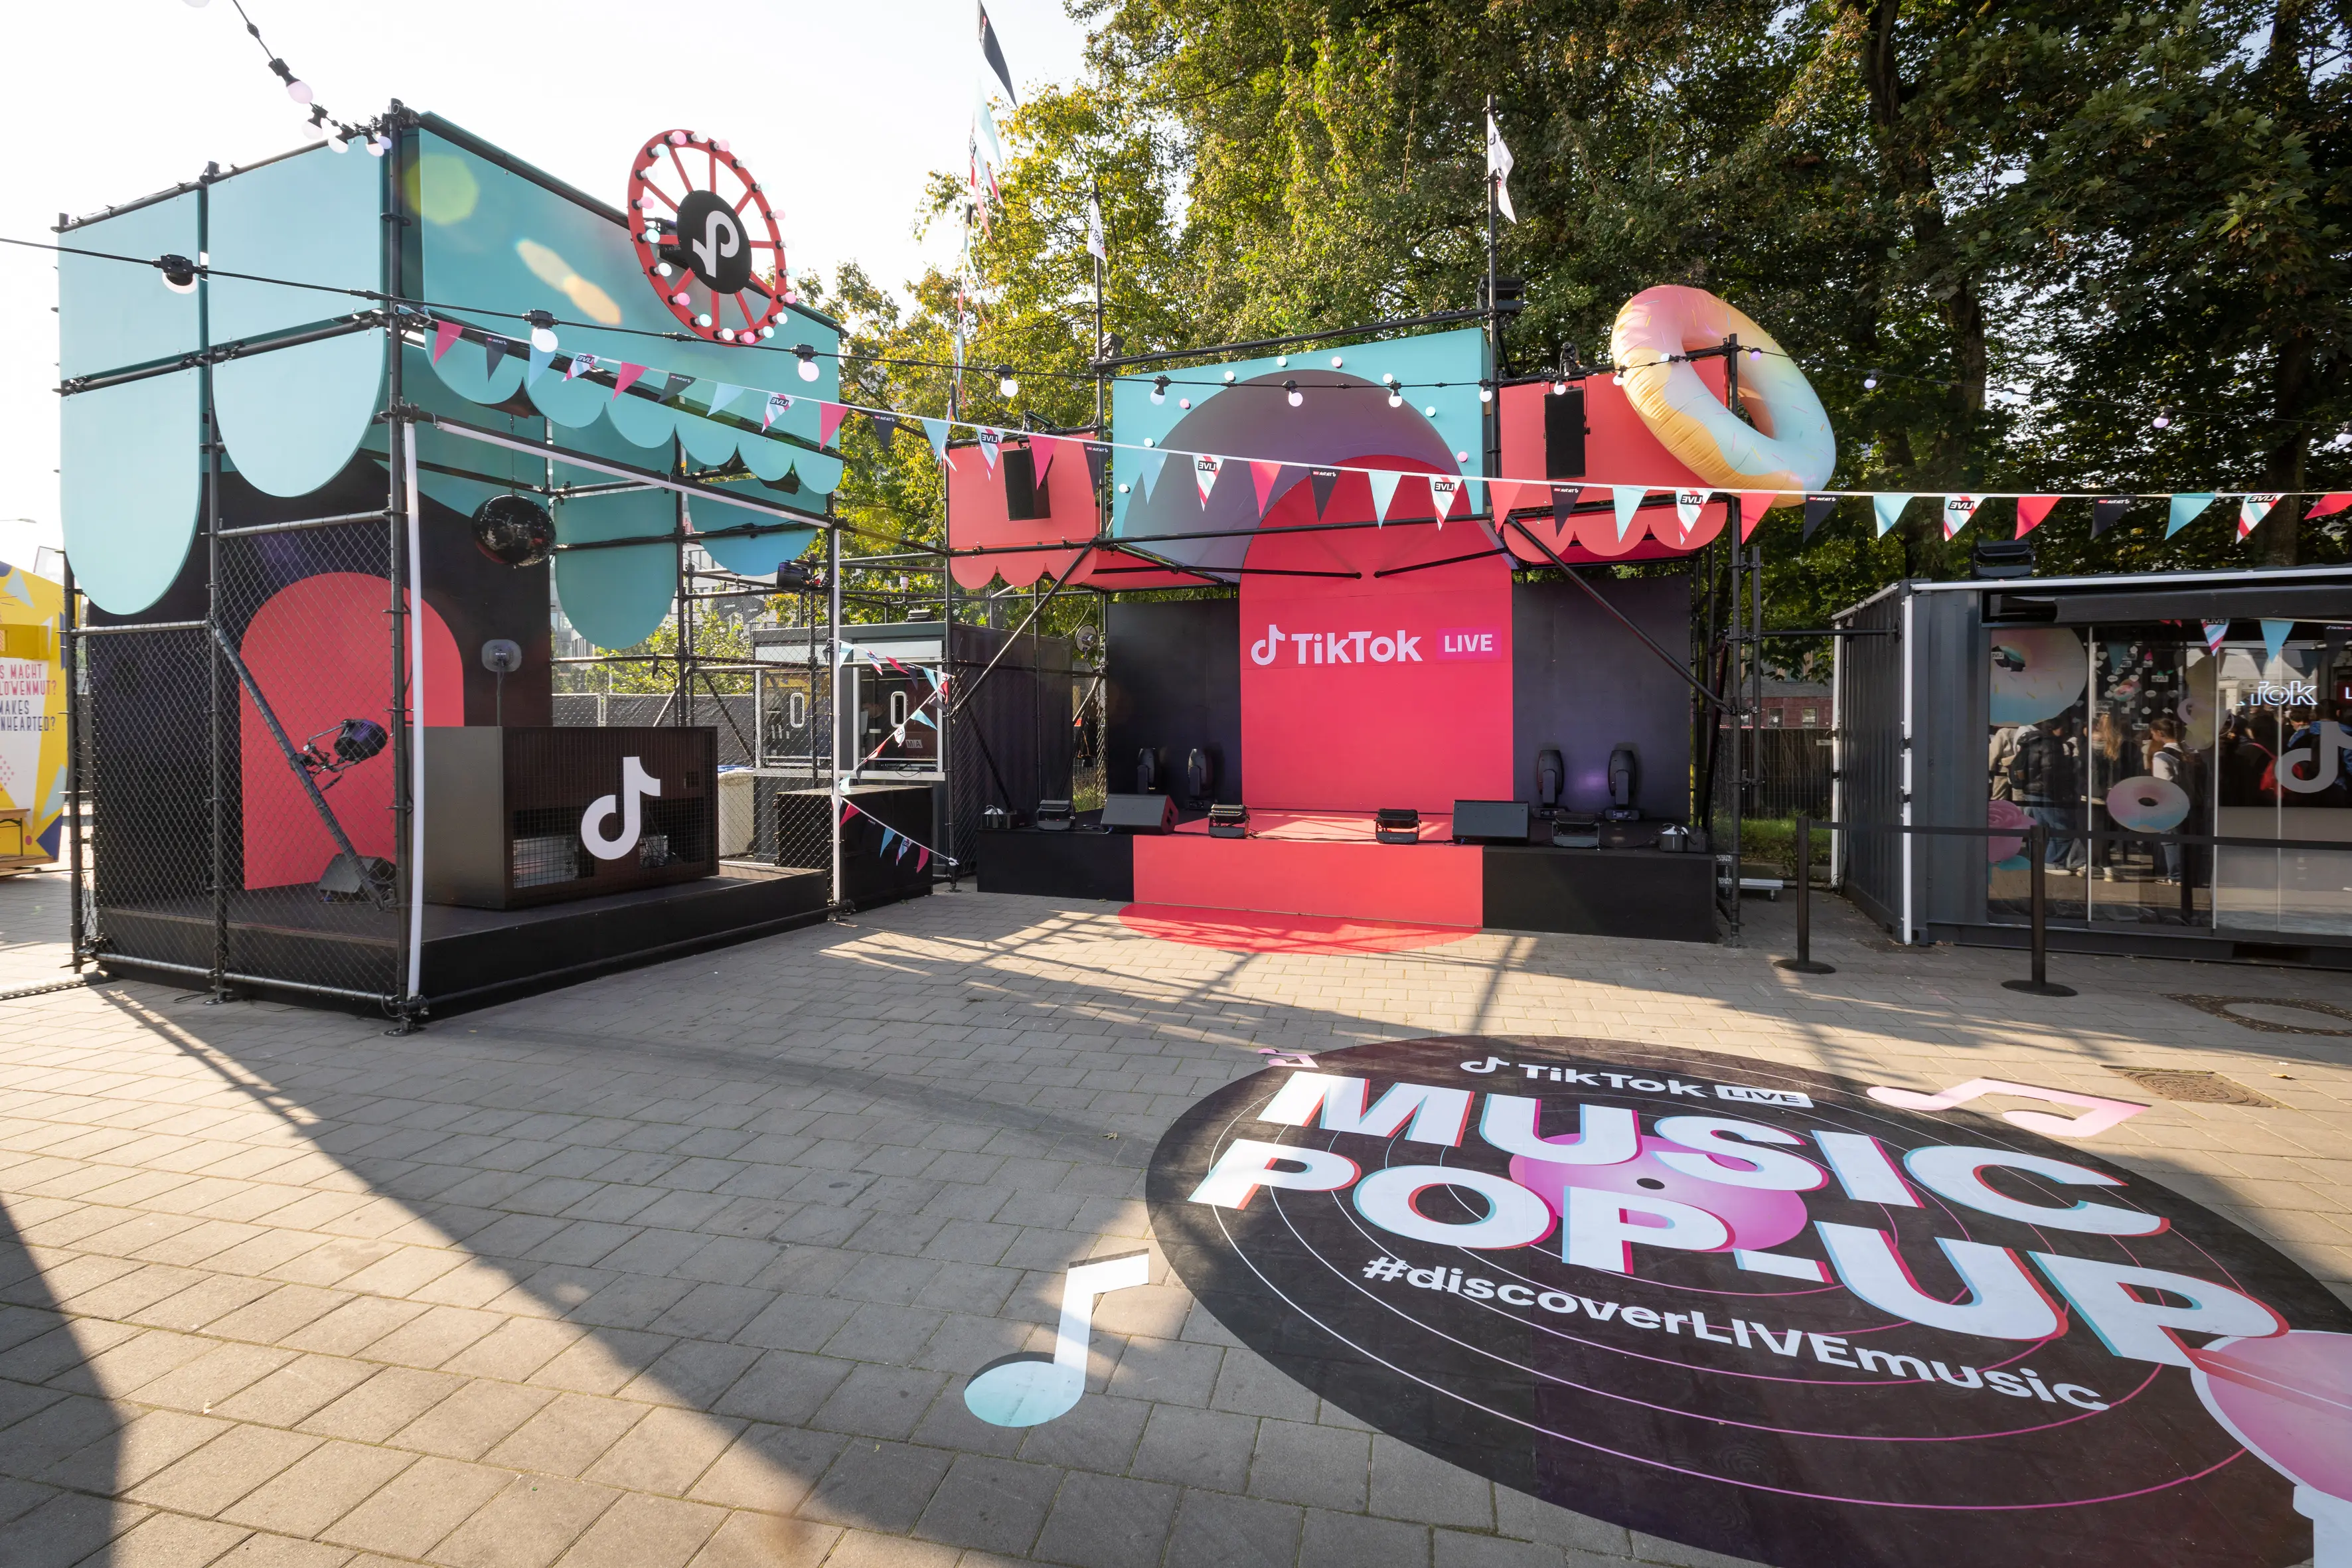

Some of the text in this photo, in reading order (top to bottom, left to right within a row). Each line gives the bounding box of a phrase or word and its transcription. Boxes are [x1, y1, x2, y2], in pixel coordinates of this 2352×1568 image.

[1291, 629, 1493, 665] TikTok LIVE
[11, 664, 42, 678] MACHT
[1, 716, 55, 731] NHEARTED?
[1518, 1063, 1800, 1103] TikTok LIVE
[1257, 1070, 2171, 1237] MUSIC
[1187, 1138, 2290, 1368] POP-UP
[1363, 1256, 2111, 1411] #discoverLIVEmusic
